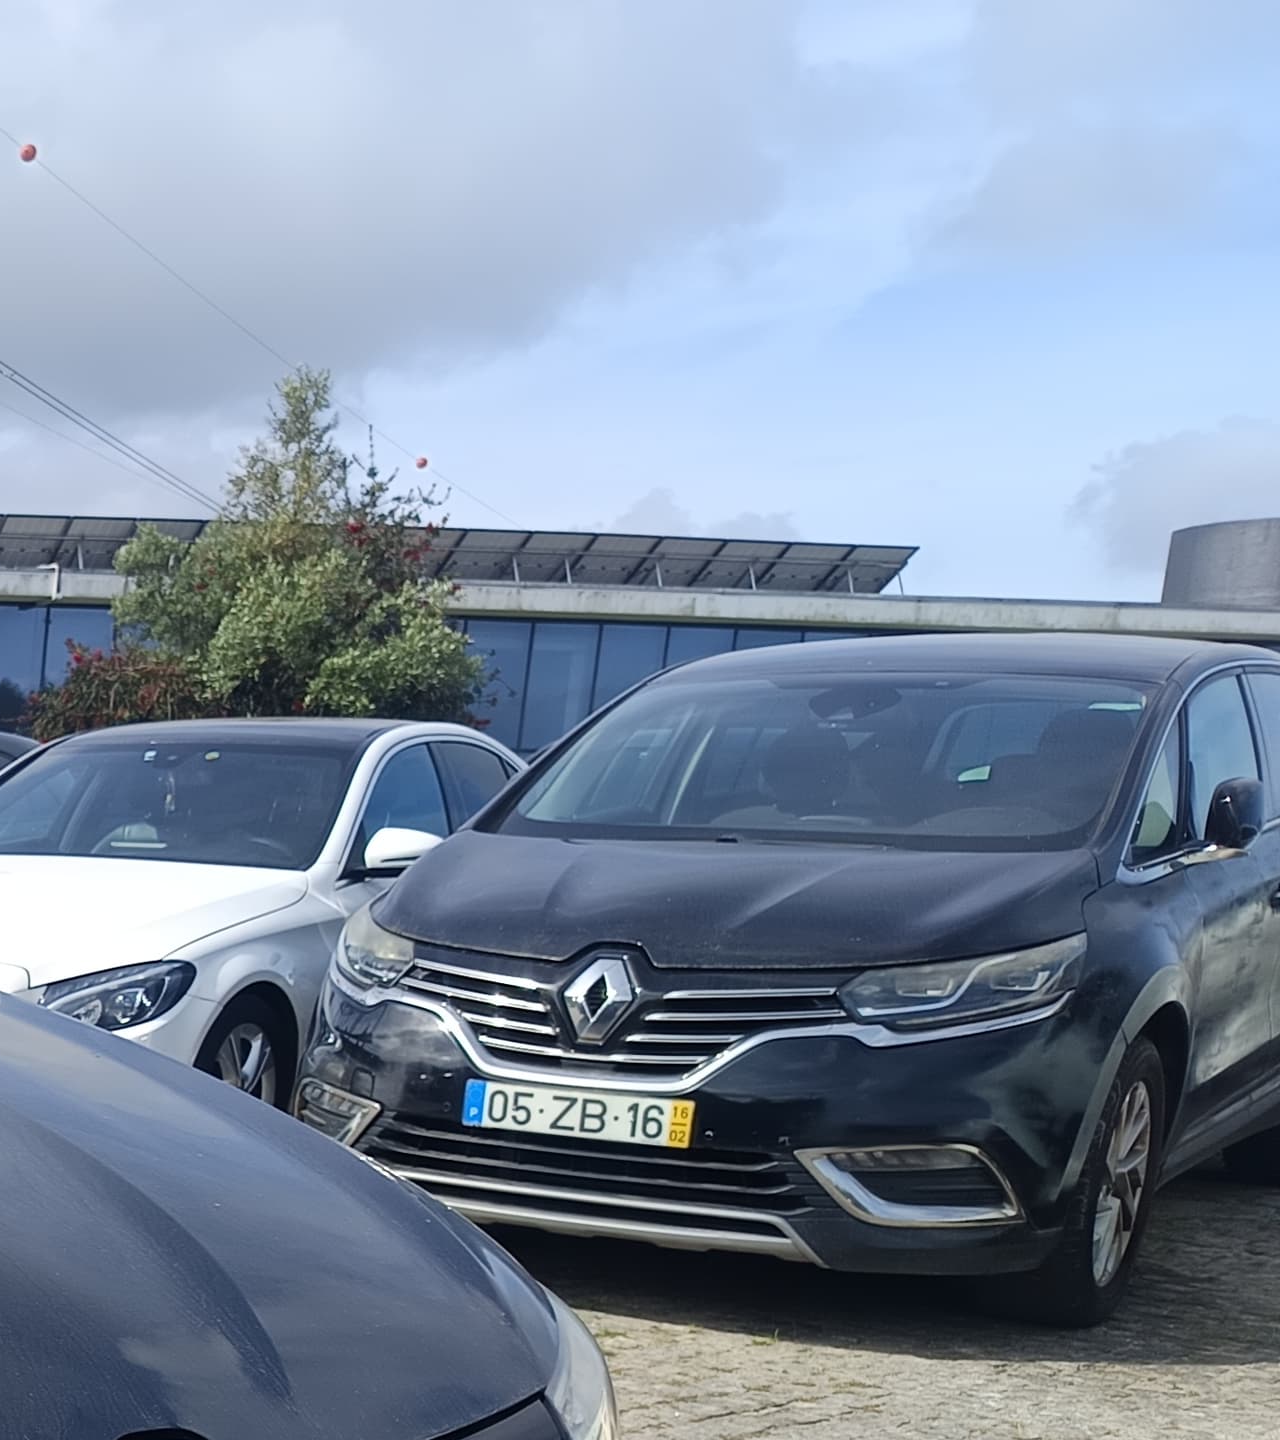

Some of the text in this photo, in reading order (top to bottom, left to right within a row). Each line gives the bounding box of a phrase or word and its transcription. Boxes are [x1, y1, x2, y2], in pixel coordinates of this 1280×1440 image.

[469, 1106, 478, 1117] P
[672, 1105, 689, 1119] 16
[669, 1130, 686, 1143] 02
